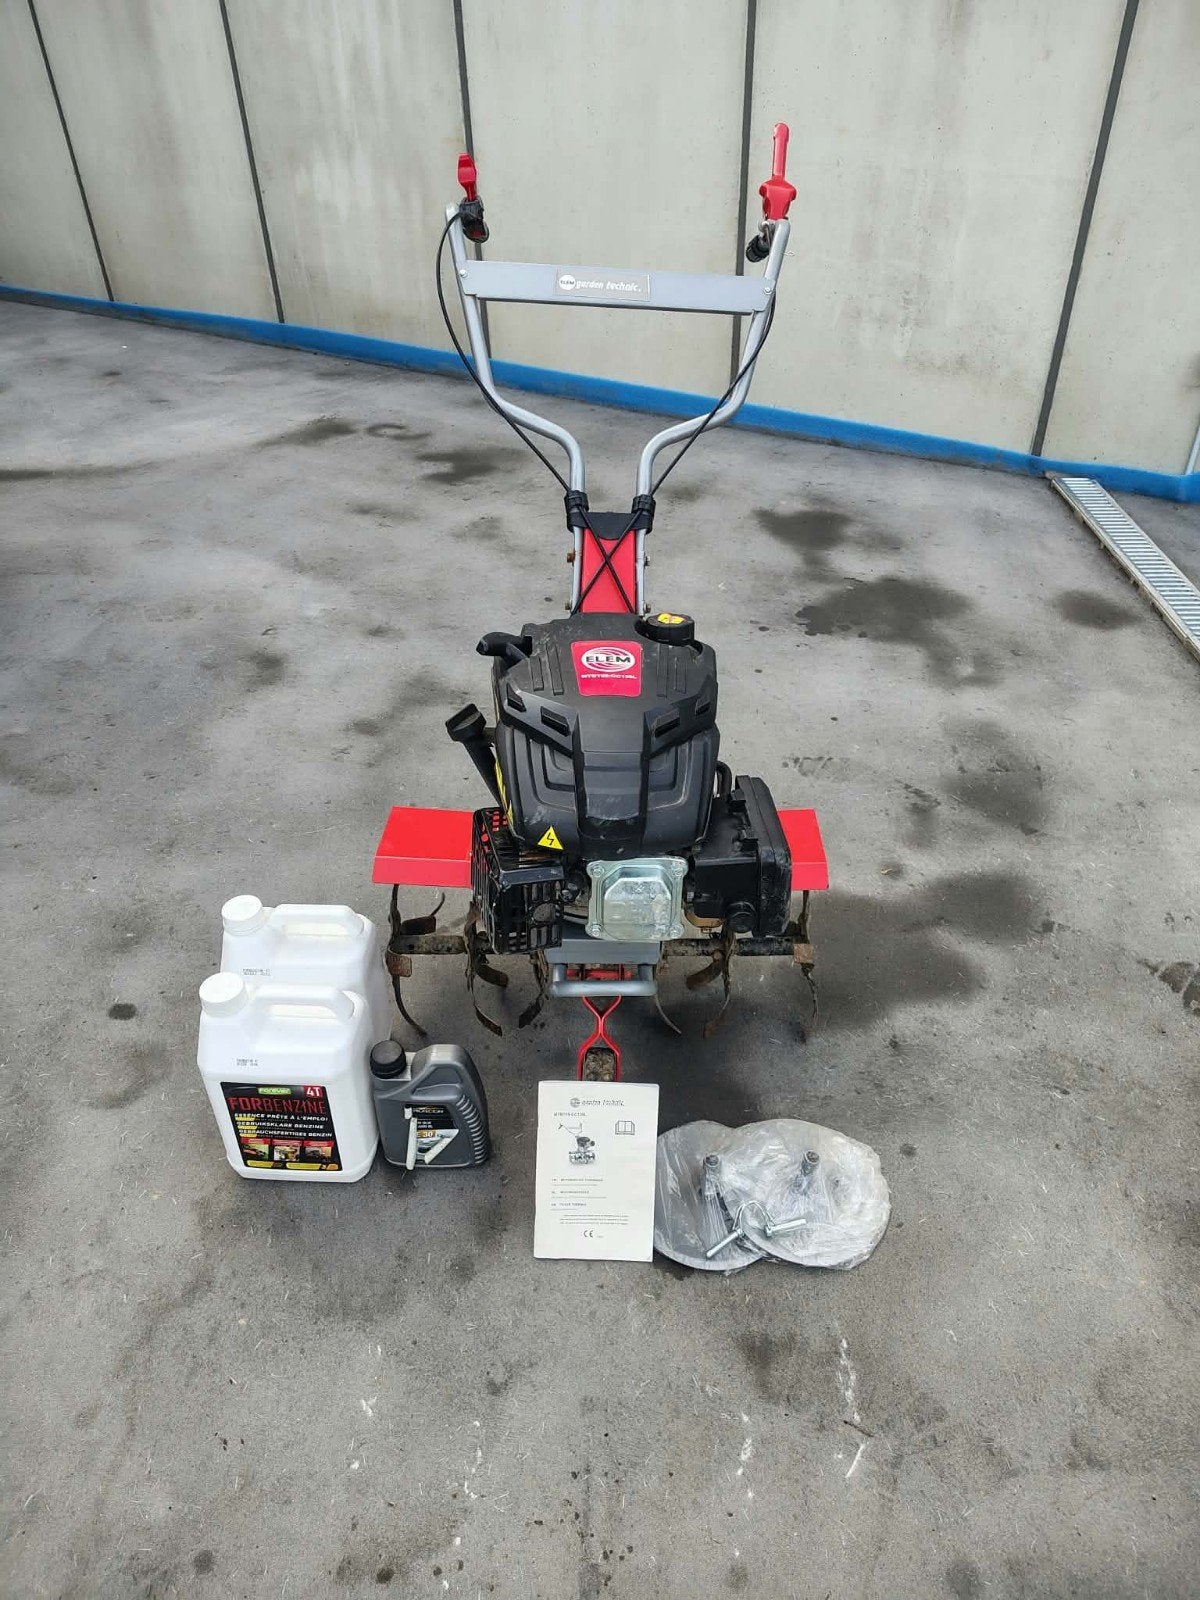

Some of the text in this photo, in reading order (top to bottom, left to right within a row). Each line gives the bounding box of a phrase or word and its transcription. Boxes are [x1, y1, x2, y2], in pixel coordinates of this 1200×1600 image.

[575, 280, 604, 290] garden
[306, 1086, 320, 1097] 4T
[228, 1097, 327, 1114] FORBENZINE
